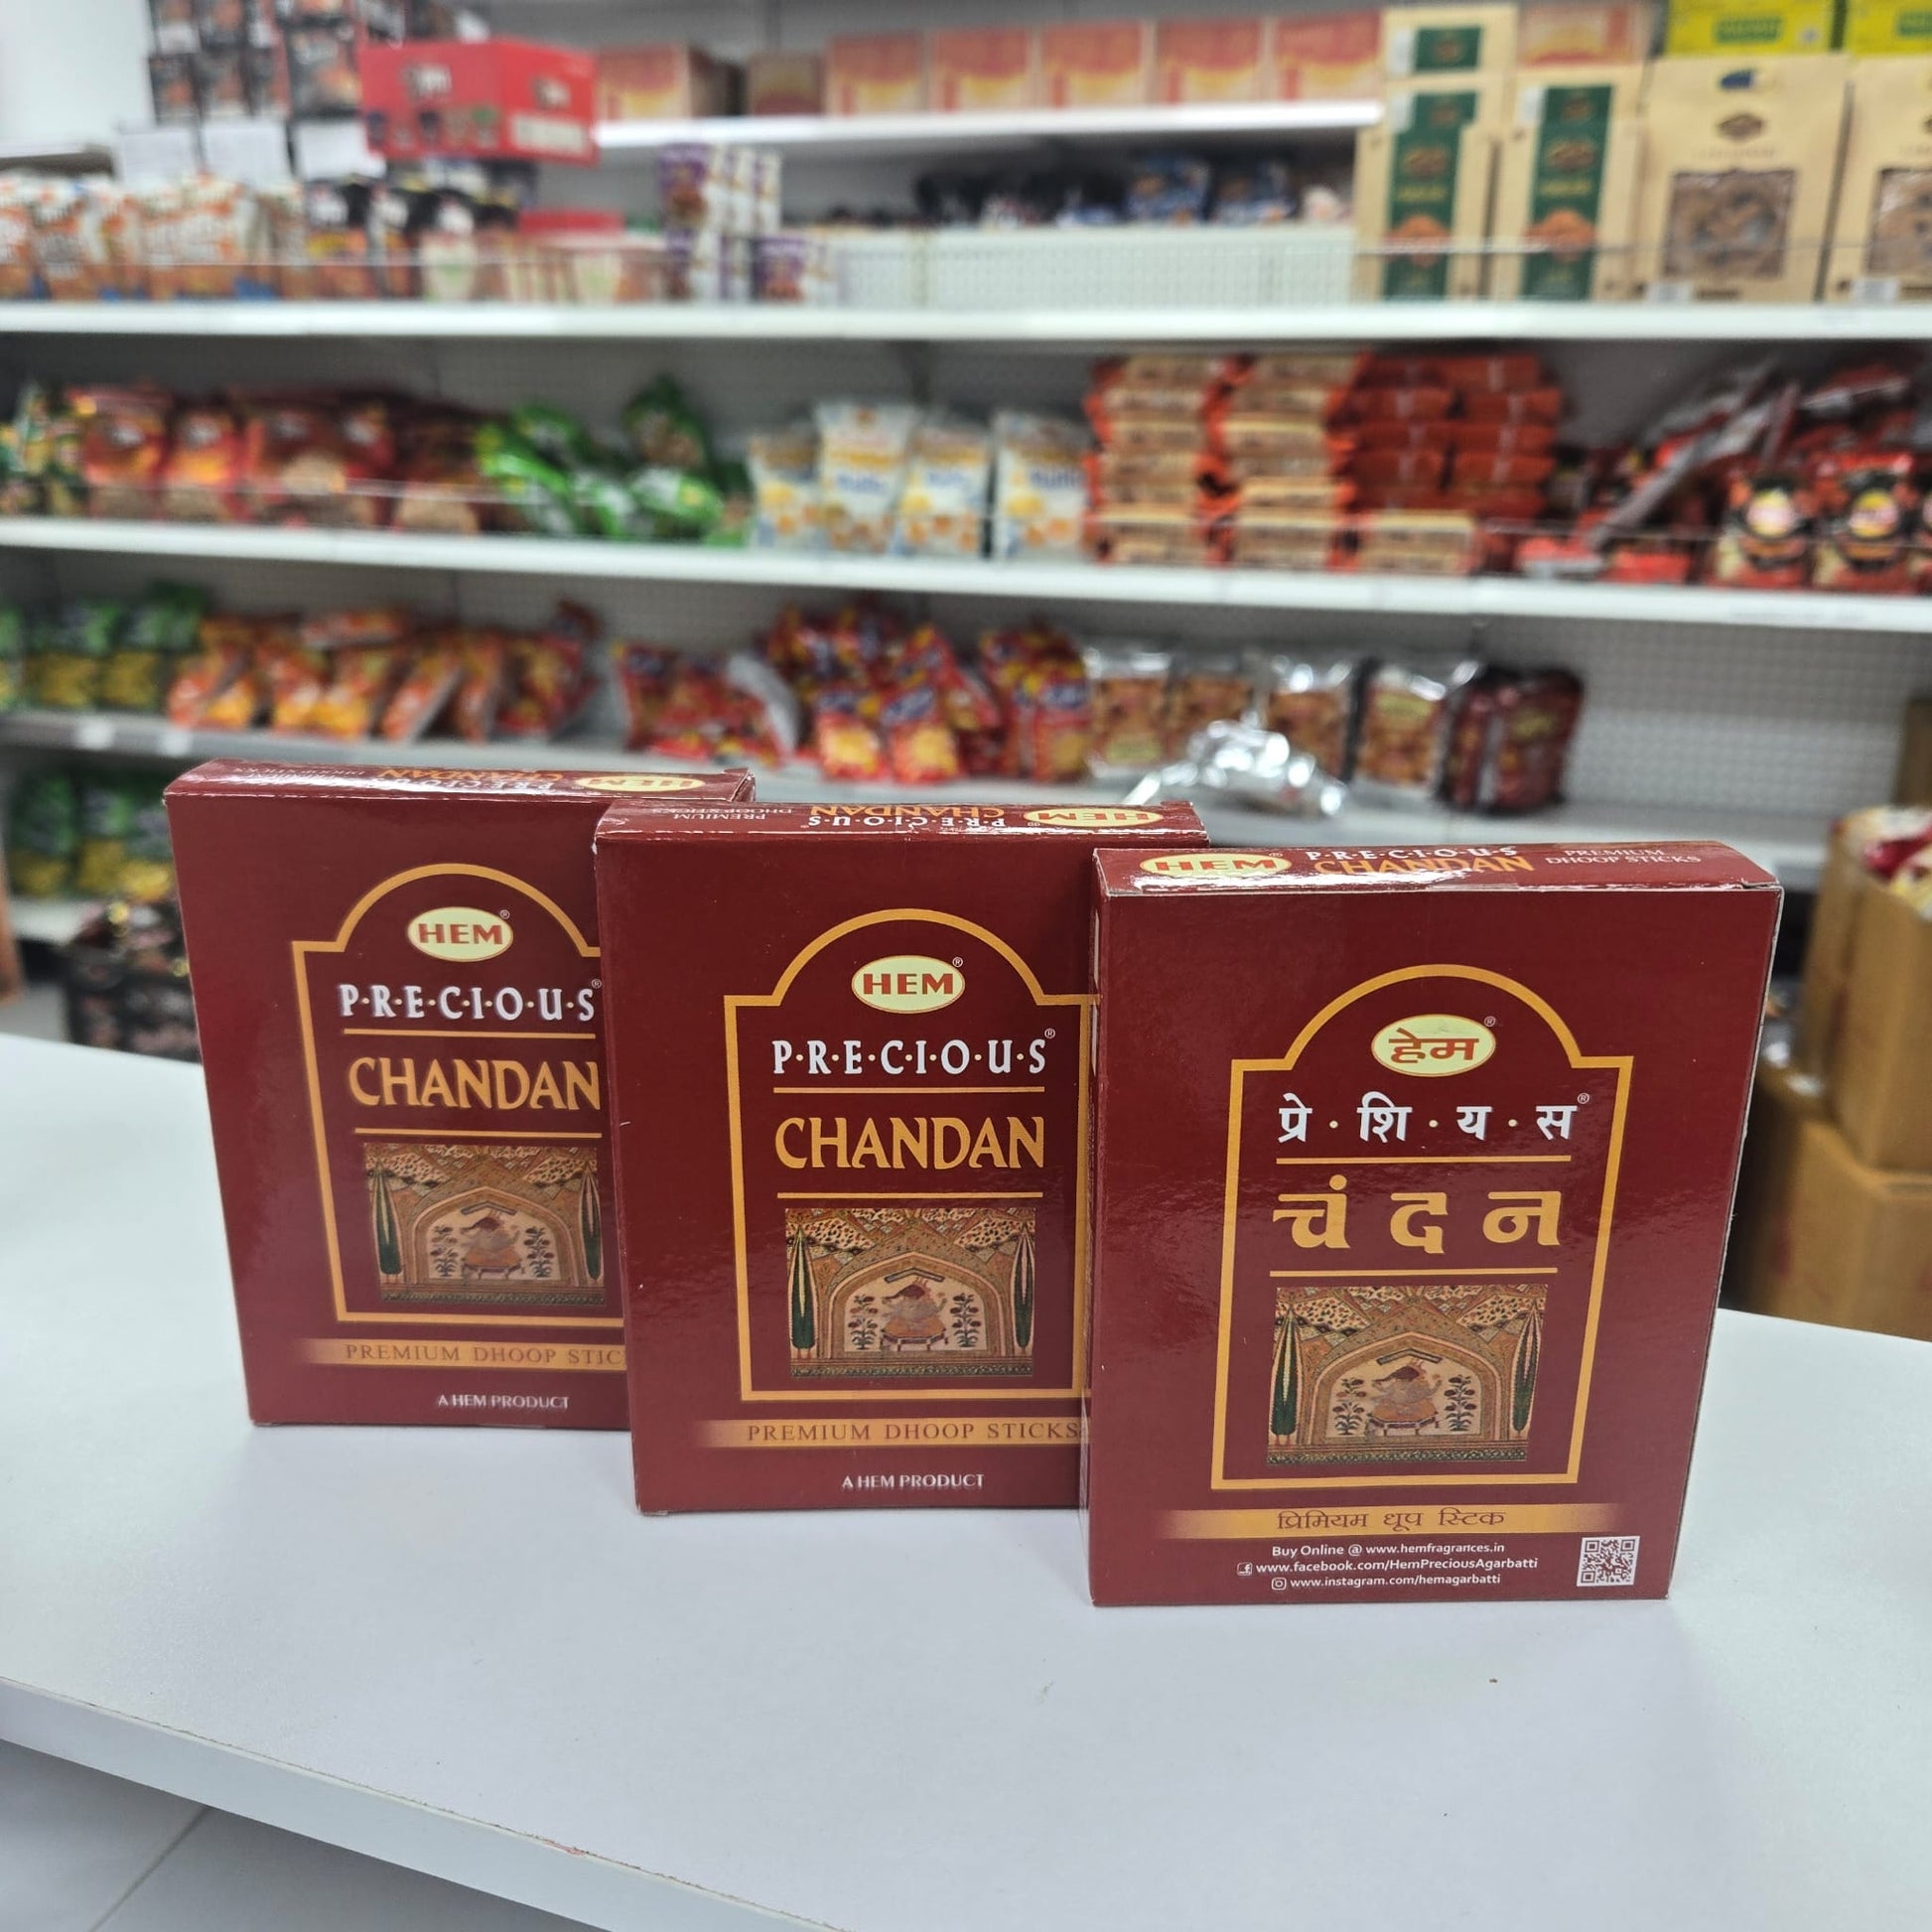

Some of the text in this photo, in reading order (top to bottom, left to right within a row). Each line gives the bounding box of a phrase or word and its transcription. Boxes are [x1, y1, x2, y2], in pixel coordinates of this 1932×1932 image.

[586, 778, 693, 787] HEM
[809, 806, 1005, 818] CHANDAN
[1036, 812, 1150, 821] HEM
[1154, 859, 1278, 872] HEM
[1312, 856, 1535, 875] CHANDAN
[1546, 855, 1702, 865] DHOOP STICKS
[417, 923, 503, 945] HEM
[863, 973, 953, 995] HEM
[1388, 1027, 1480, 1064] हेम
[348, 1056, 601, 1111] CHANDAN
[774, 1117, 1044, 1170] CHANDAN
[345, 1343, 622, 1365] PREMIUM DHOOP STIC
[438, 1394, 570, 1410] A HEM PRODUCT
[748, 1421, 1078, 1442] PREMIUM DHOOP STICKS
[842, 1473, 985, 1488] A HEM PRODUCT
[1383, 1512, 1424, 1532] धूप
[1438, 1507, 1506, 1527] स्टिक
[1272, 1542, 1505, 1559] Buy Online @ www.hemfragrances.in
[1256, 1557, 1539, 1573] www.facebook.com/HemPreciousAgarbatti
[1290, 1573, 1502, 1587] www.instagram.com/hemagarbatti
